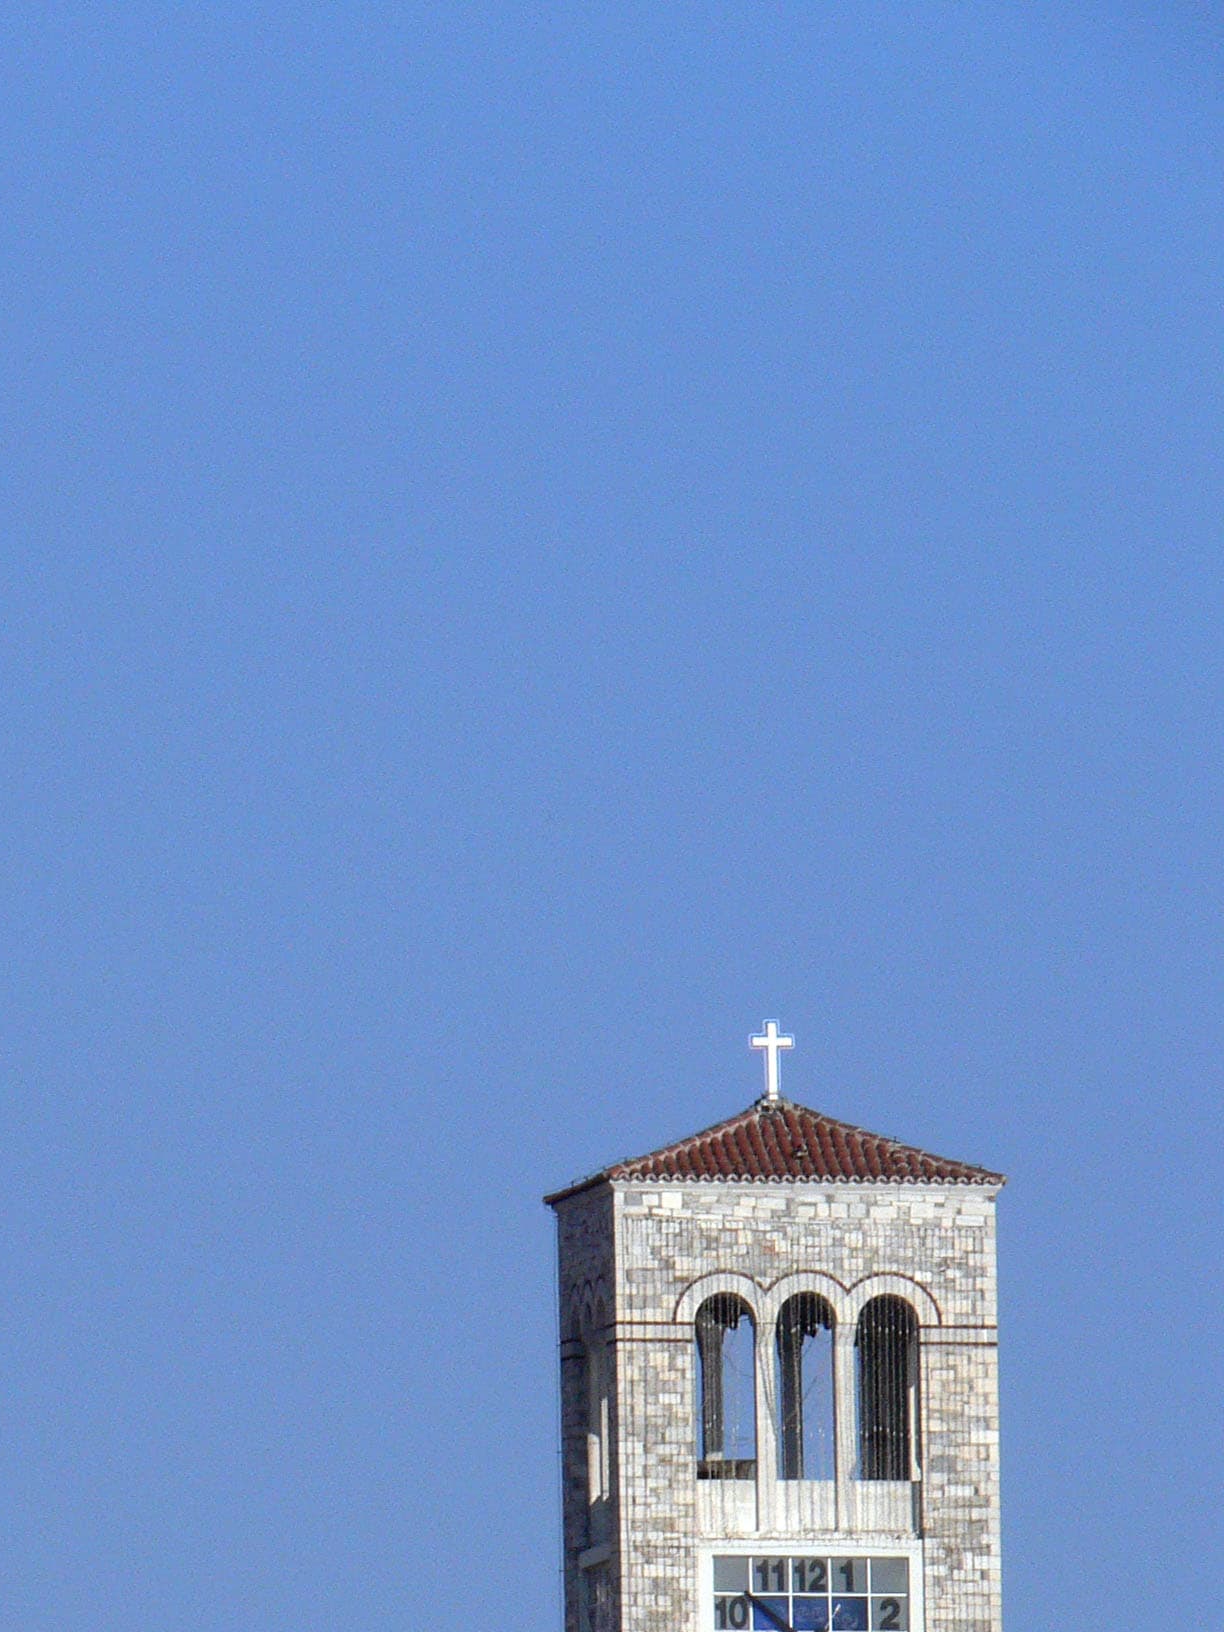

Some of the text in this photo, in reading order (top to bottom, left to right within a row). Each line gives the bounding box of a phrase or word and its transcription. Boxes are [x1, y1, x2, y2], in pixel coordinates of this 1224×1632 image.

[756, 1559, 785, 1591] 11
[795, 1559, 826, 1591] 12
[840, 1560, 854, 1591] 1
[715, 1596, 749, 1629] 10
[880, 1598, 900, 1630] 2
